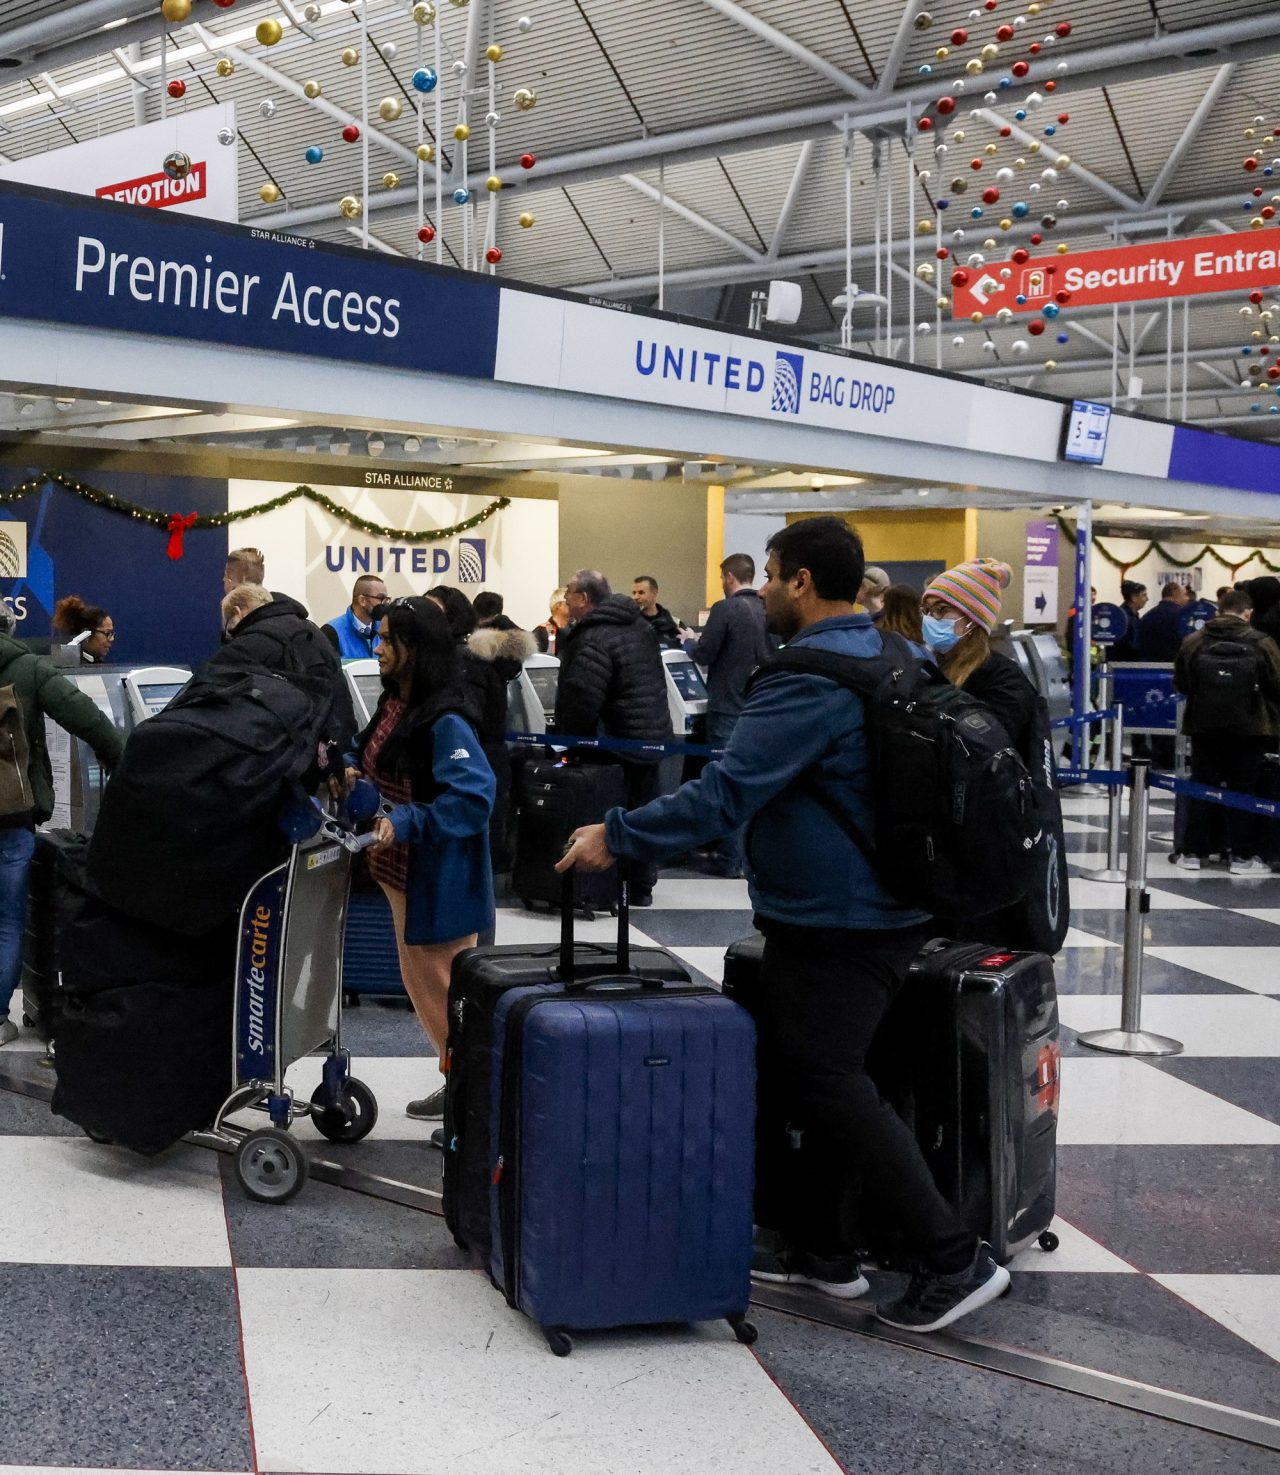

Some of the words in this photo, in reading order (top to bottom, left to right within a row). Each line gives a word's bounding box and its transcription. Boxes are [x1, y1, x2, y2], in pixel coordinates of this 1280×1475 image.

[250, 228, 270, 240] STAR
[271, 232, 307, 248] ALLIANCE
[75, 235, 260, 316] Premier
[271, 271, 401, 338] Access
[1064, 258, 1185, 292] Security
[1194, 248, 1280, 277] Entra
[636, 339, 765, 393] UNITED
[809, 371, 845, 407] BAG
[849, 379, 895, 414] DROP
[365, 472, 397, 486] STAR
[398, 475, 442, 490] ALLIANCE
[325, 544, 451, 574] UNITED
[246, 904, 271, 1056] smartecarte
